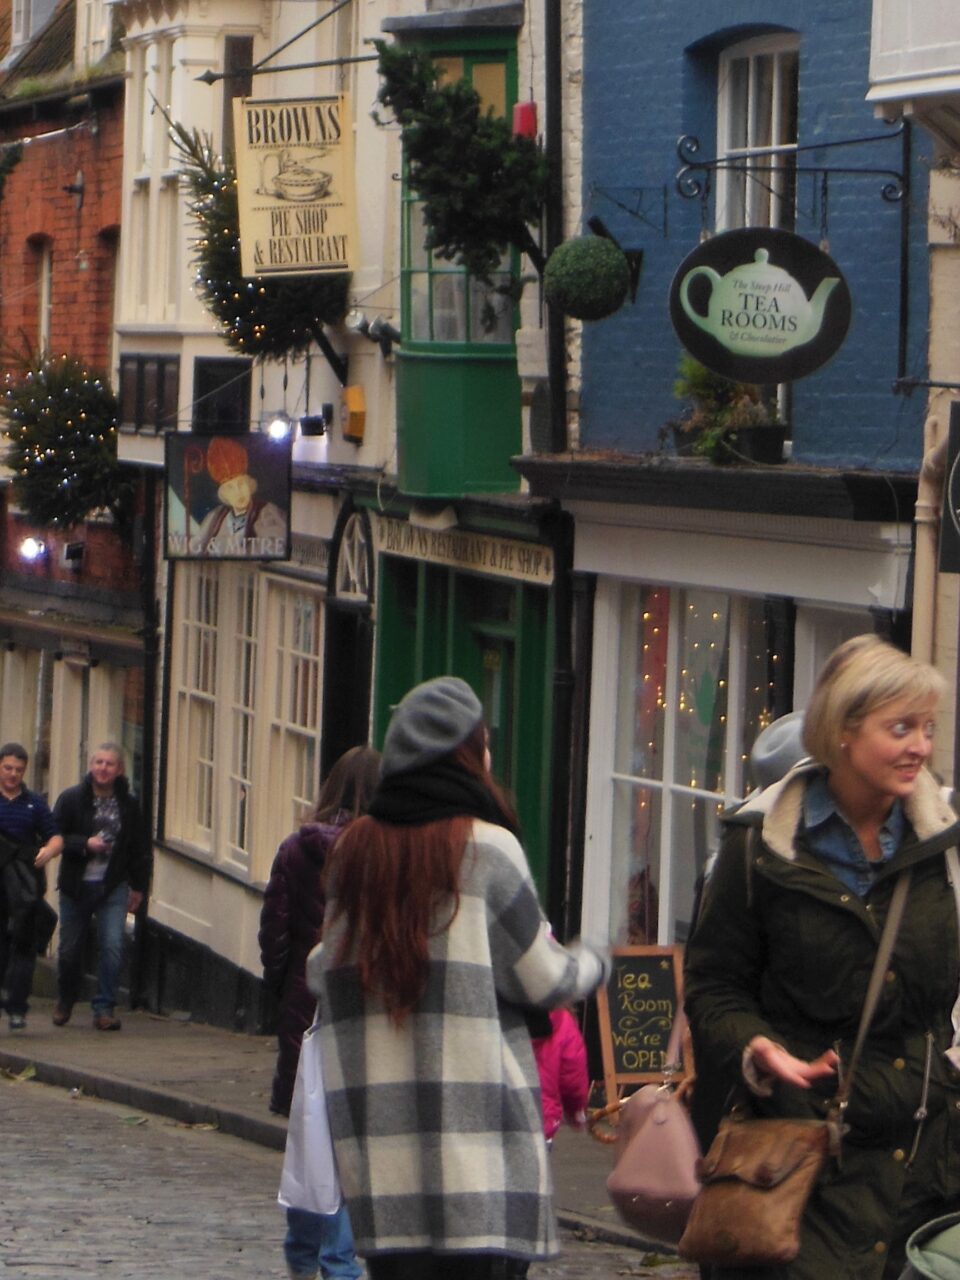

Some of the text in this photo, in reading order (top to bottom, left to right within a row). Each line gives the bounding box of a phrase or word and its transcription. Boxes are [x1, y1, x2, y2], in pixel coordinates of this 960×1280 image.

[247, 105, 341, 144] BROWNS
[271, 208, 328, 237] PIE SHOP
[254, 235, 348, 265] & RESTAURANT
[774, 282, 792, 293] Hill
[739, 293, 780, 313] TEA
[721, 309, 798, 332] ROOMS
[206, 536, 223, 554] &
[225, 536, 284, 554] MITRE
[387, 520, 429, 556] BROWNS
[517, 548, 541, 576] SHOP
[616, 964, 652, 989] Tea
[618, 990, 673, 1018] Room
[612, 1030, 661, 1047] We're
